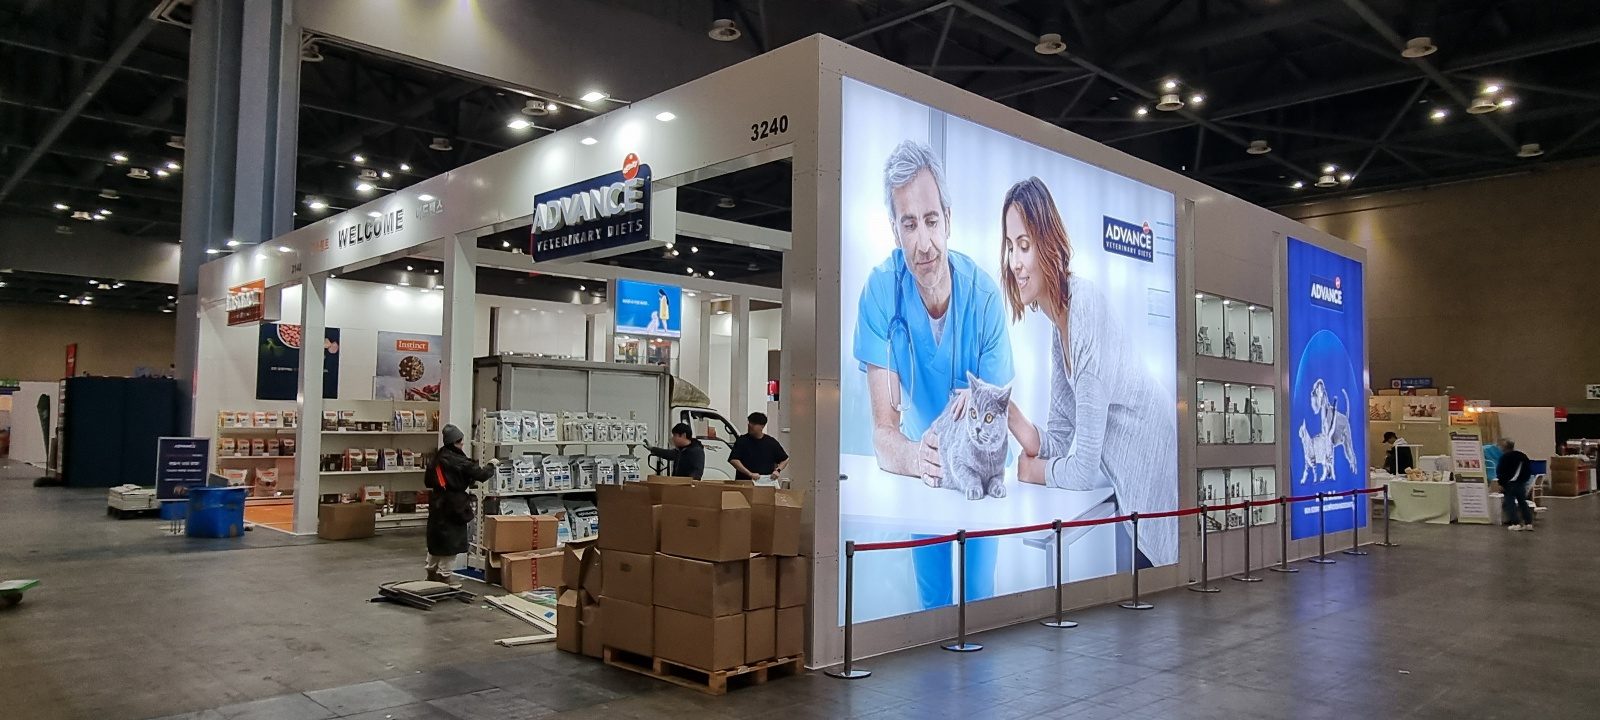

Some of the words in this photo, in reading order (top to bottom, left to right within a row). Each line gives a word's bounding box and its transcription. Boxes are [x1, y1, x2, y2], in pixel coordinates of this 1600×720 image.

[751, 115, 789, 142] 3240
[531, 178, 645, 234] ADVANCE
[338, 209, 404, 249] WELCOME
[536, 226, 601, 252] VETERINARY
[607, 219, 644, 239] DIETS
[1105, 223, 1152, 250] ADVANCE
[1105, 241, 1137, 255] VETERINARY
[1137, 248, 1152, 259] DIETS
[1311, 283, 1343, 305] ADVANCE
[399, 340, 426, 350] Instinct
